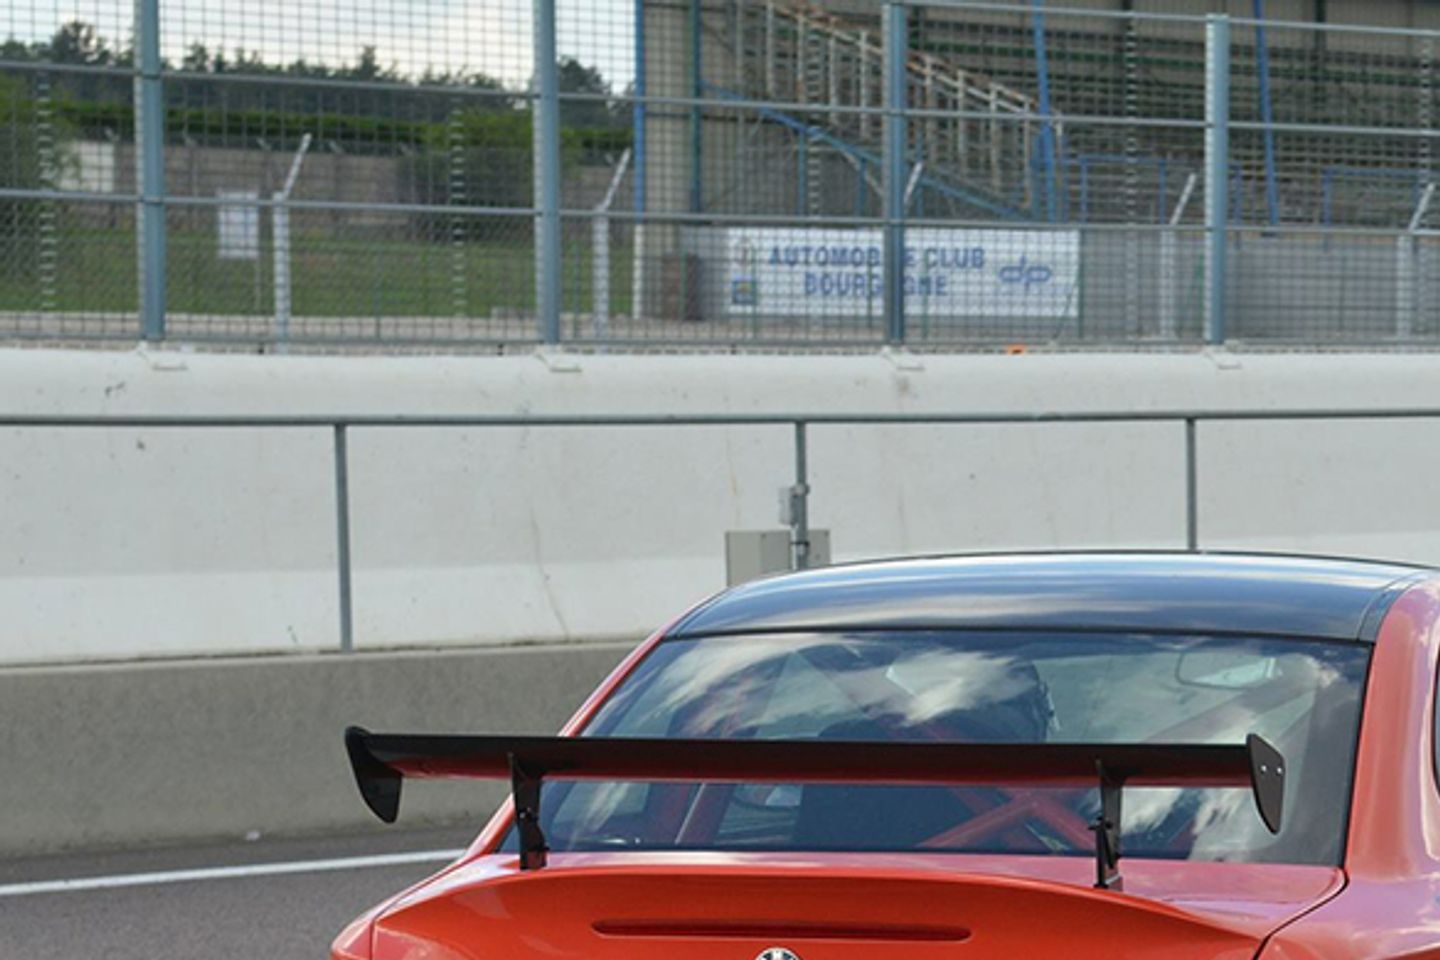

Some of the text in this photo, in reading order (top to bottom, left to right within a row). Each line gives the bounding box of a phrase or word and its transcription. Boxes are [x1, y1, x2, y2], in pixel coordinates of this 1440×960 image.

[769, 245, 984, 269] AUTOMOBE CLUB
[805, 272, 946, 296] BOURGGNE
